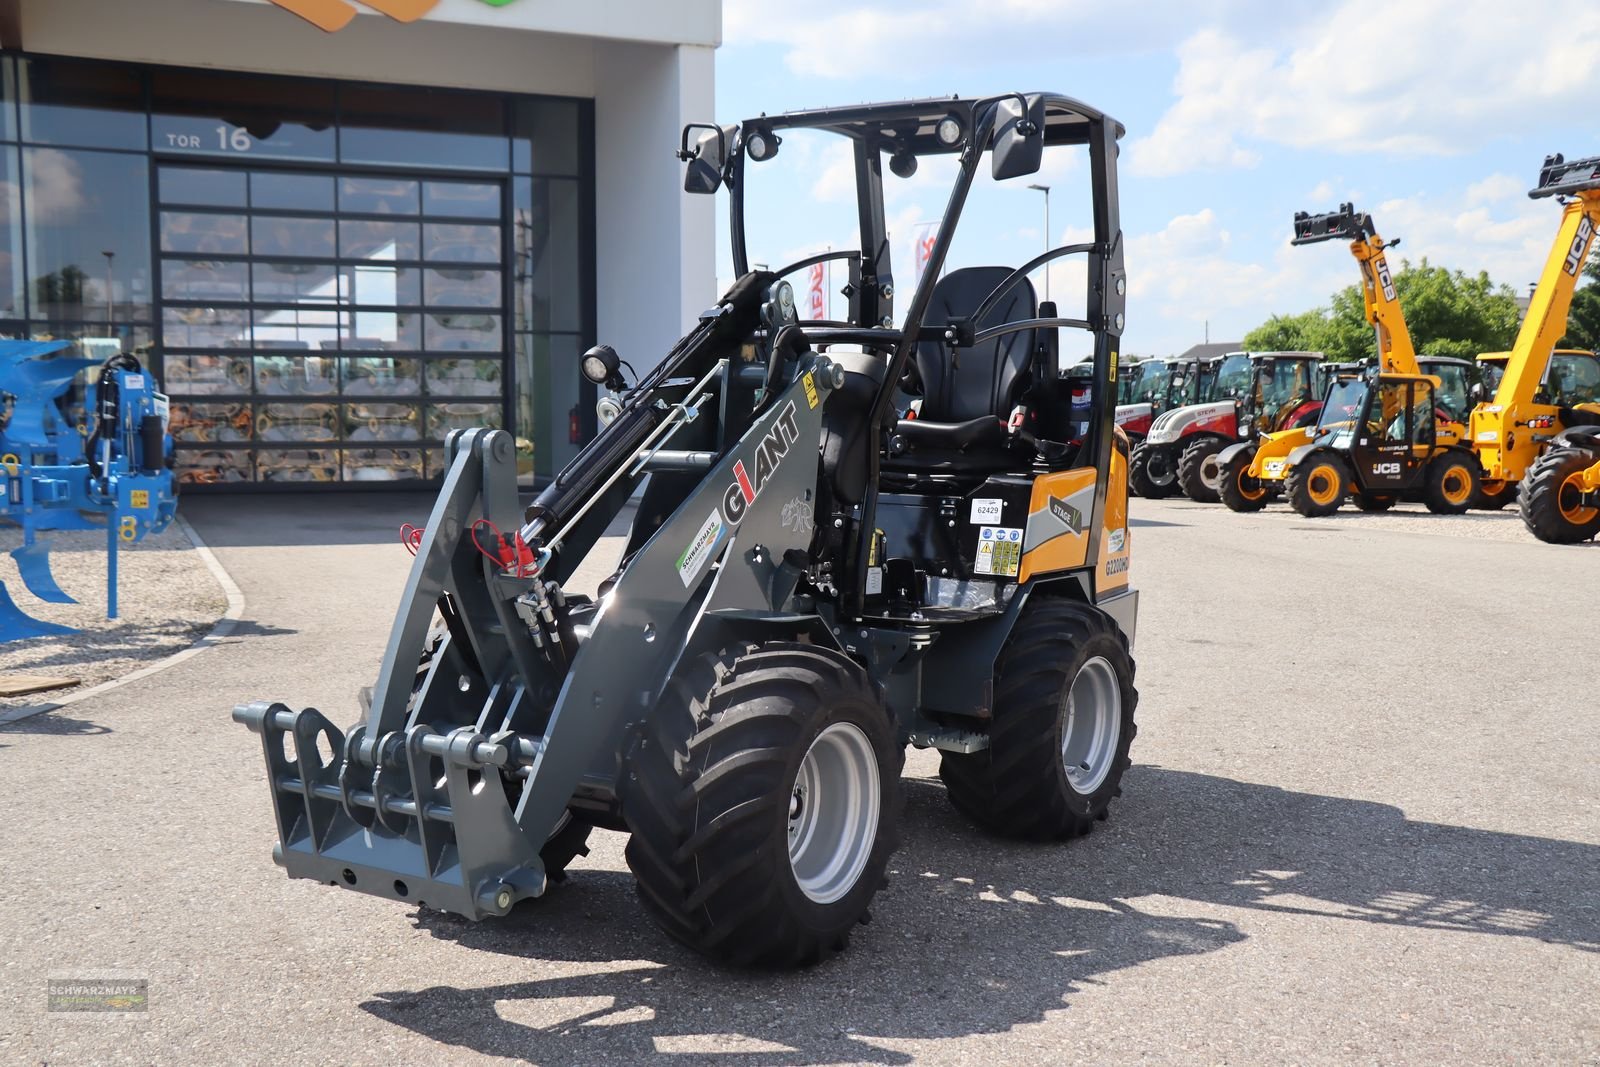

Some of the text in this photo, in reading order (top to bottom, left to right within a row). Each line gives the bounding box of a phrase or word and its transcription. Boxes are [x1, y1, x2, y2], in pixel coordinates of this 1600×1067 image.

[166, 126, 251, 151] TOR 16
[1563, 216, 1592, 275] JCB
[1375, 258, 1396, 302] JCB
[1197, 408, 1217, 416] STEYR
[723, 399, 799, 525] GIANT
[1372, 463, 1400, 475] JCB
[977, 506, 999, 514] 62429
[1053, 504, 1081, 527] STAGE V
[682, 522, 716, 570] SCHWARZMAYR
